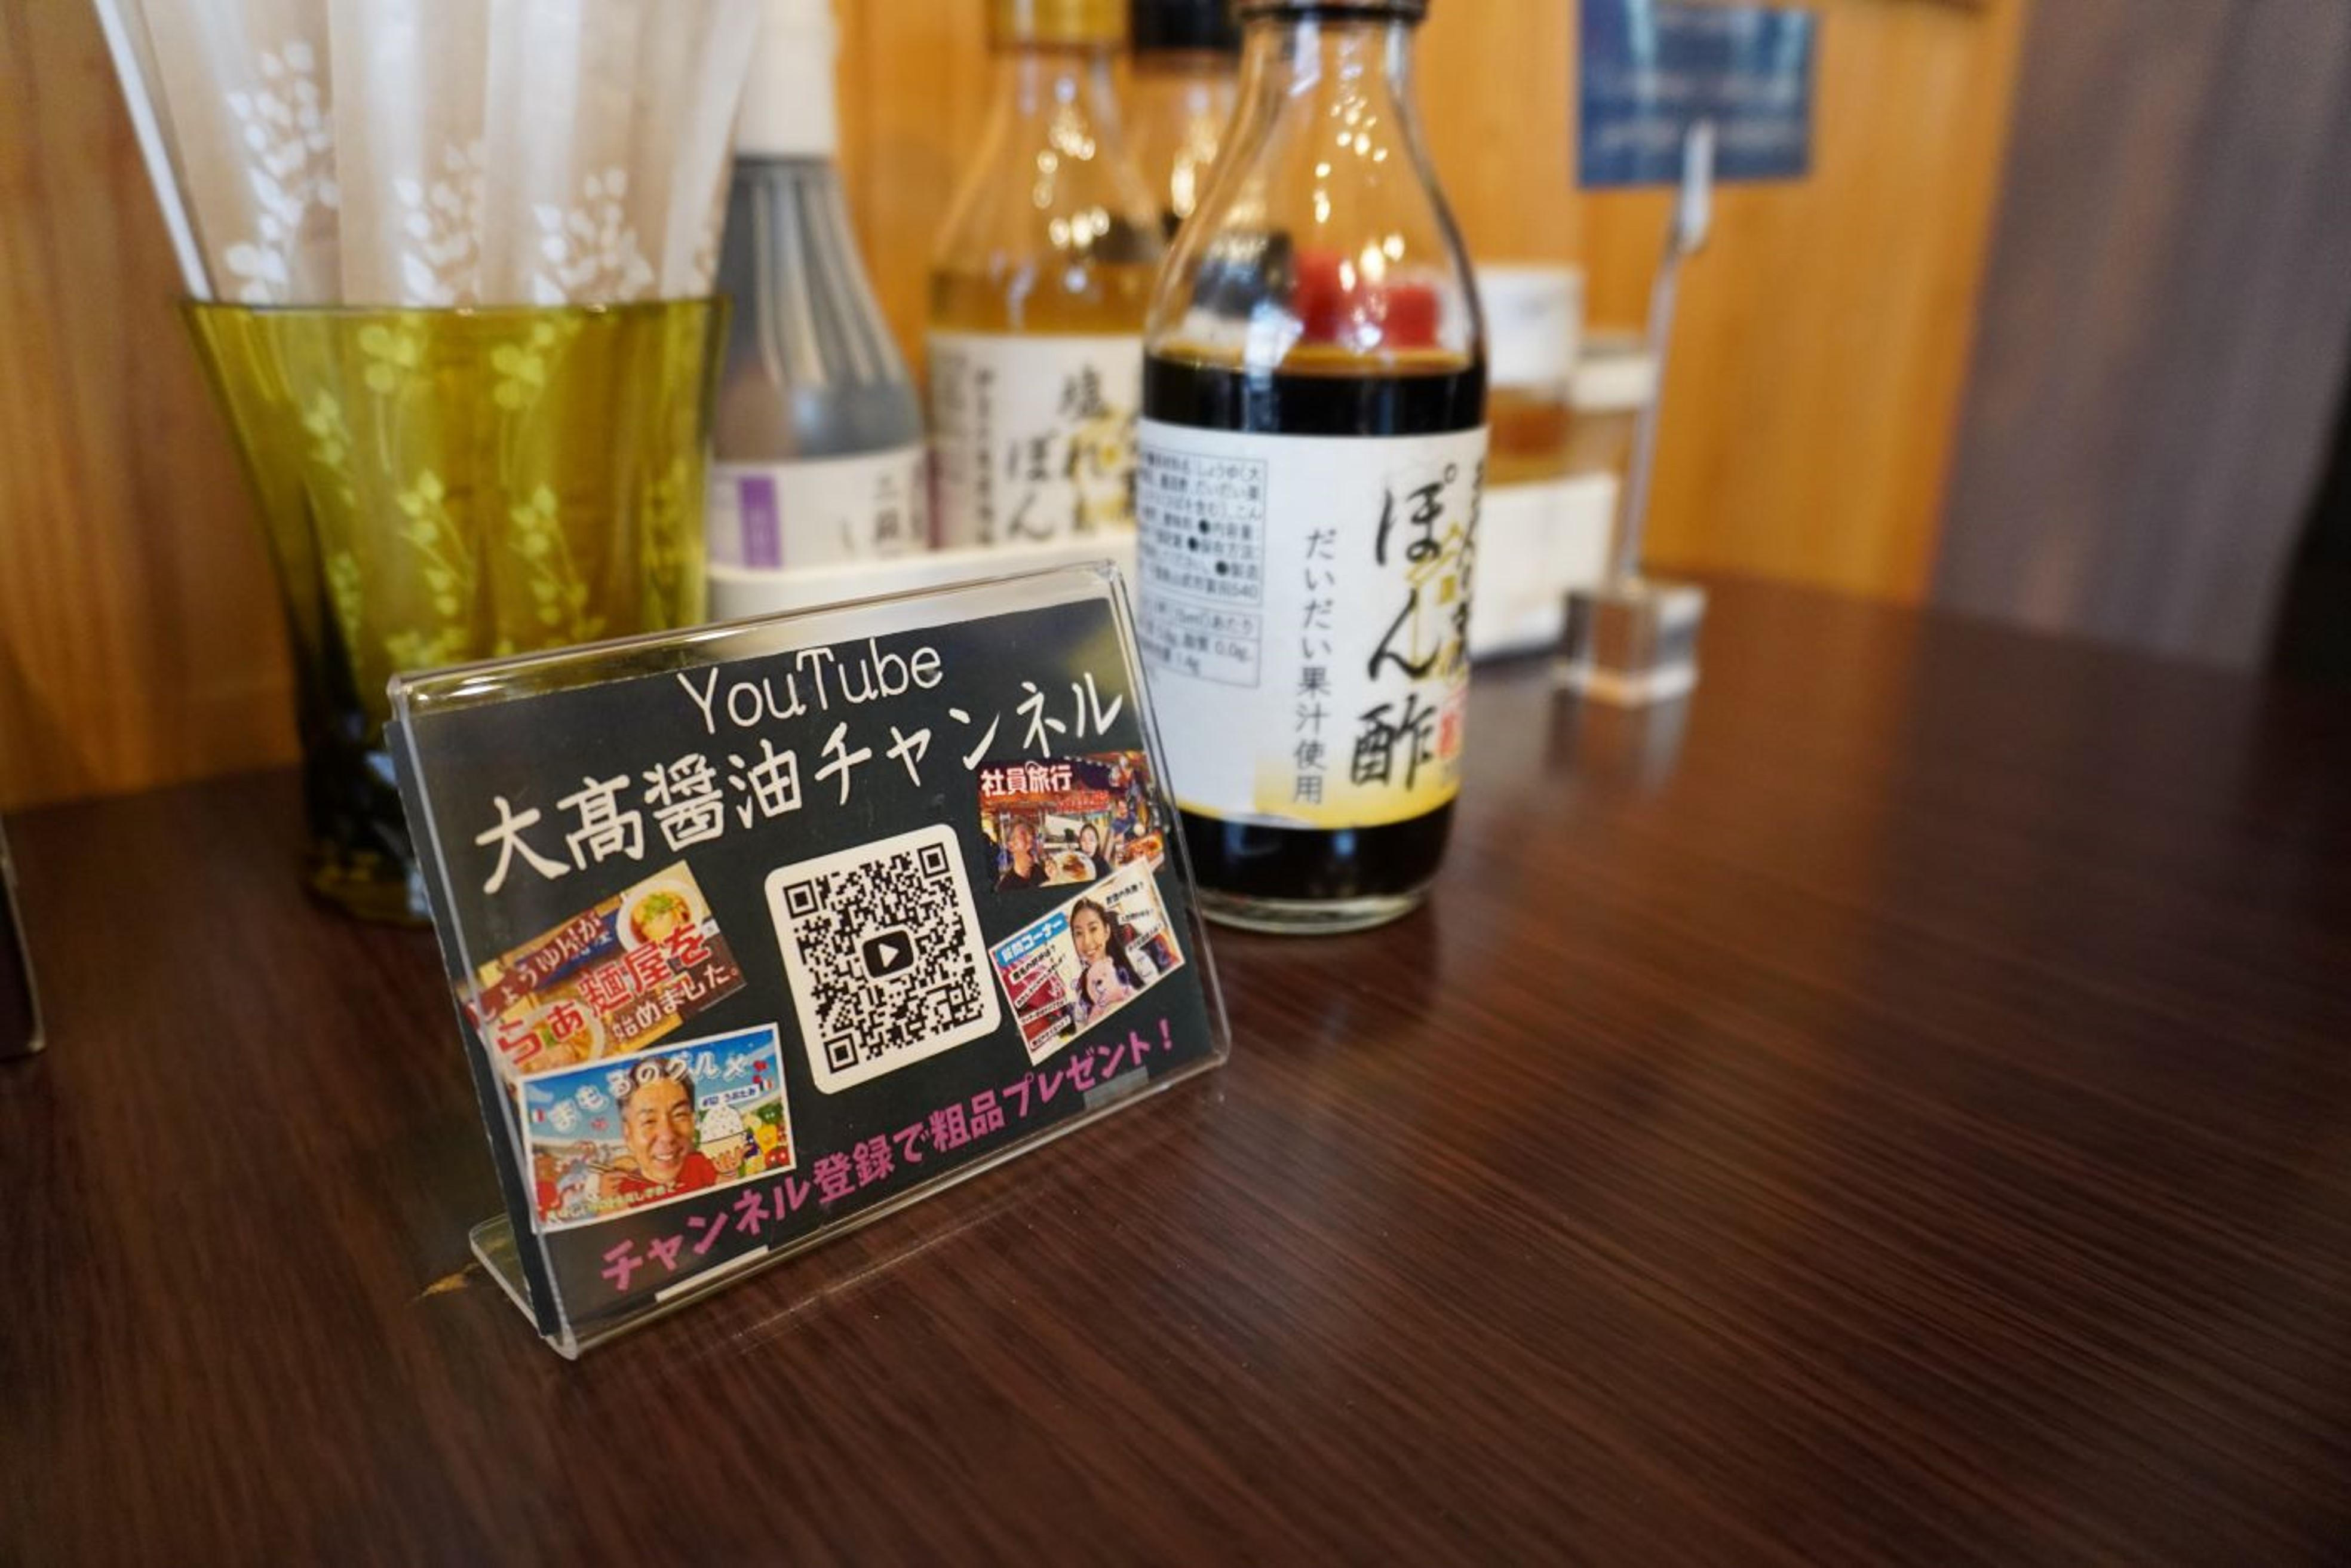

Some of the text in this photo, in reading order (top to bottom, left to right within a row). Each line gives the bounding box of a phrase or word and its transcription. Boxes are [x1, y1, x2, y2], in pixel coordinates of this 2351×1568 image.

[1293, 528, 1337, 804] だいだい果汁使用
[1349, 463, 1458, 792] ぽん酢
[677, 631, 943, 734] YouTube
[981, 763, 1073, 798] 社員旅行
[612, 963, 739, 1044] 始めました。
